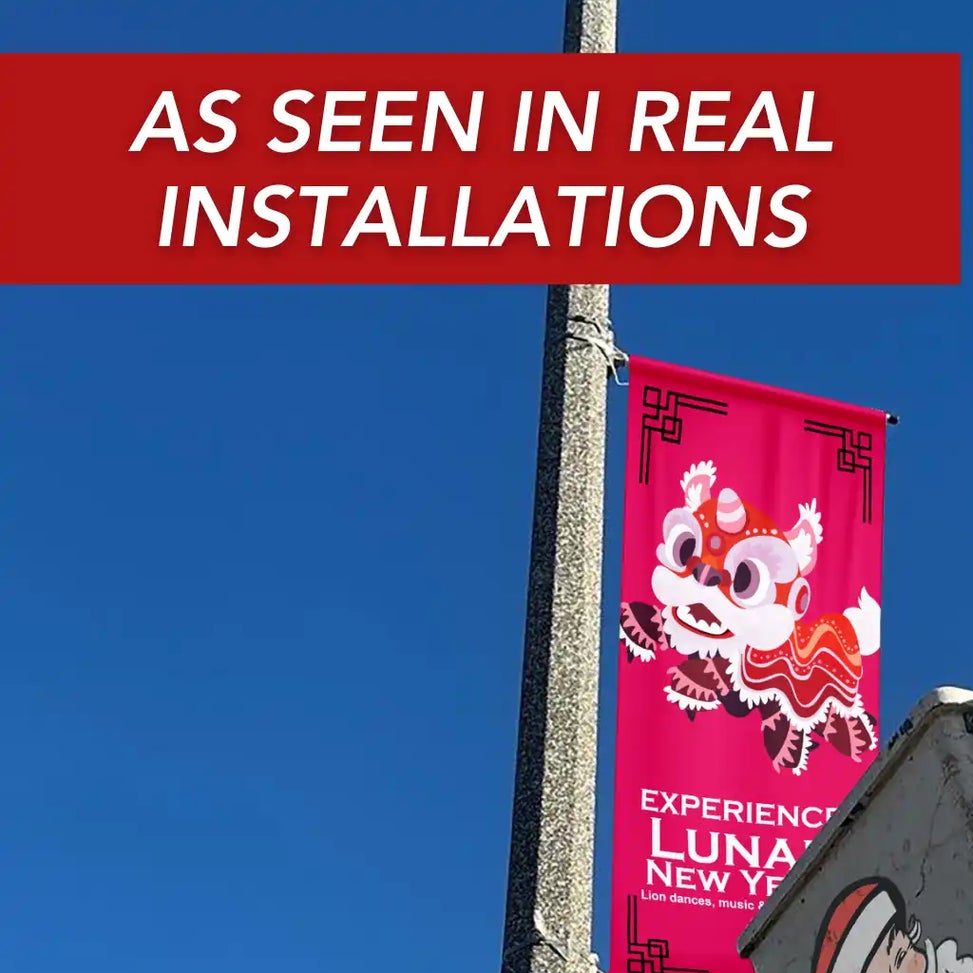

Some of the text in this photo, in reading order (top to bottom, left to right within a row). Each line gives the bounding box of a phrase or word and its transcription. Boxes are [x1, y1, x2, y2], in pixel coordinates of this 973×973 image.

[650, 816, 813, 871] LUNA
[645, 858, 785, 897] NEW YE
[640, 888, 667, 902] Lion
[669, 892, 716, 909] dances,
[718, 898, 755, 910] music
